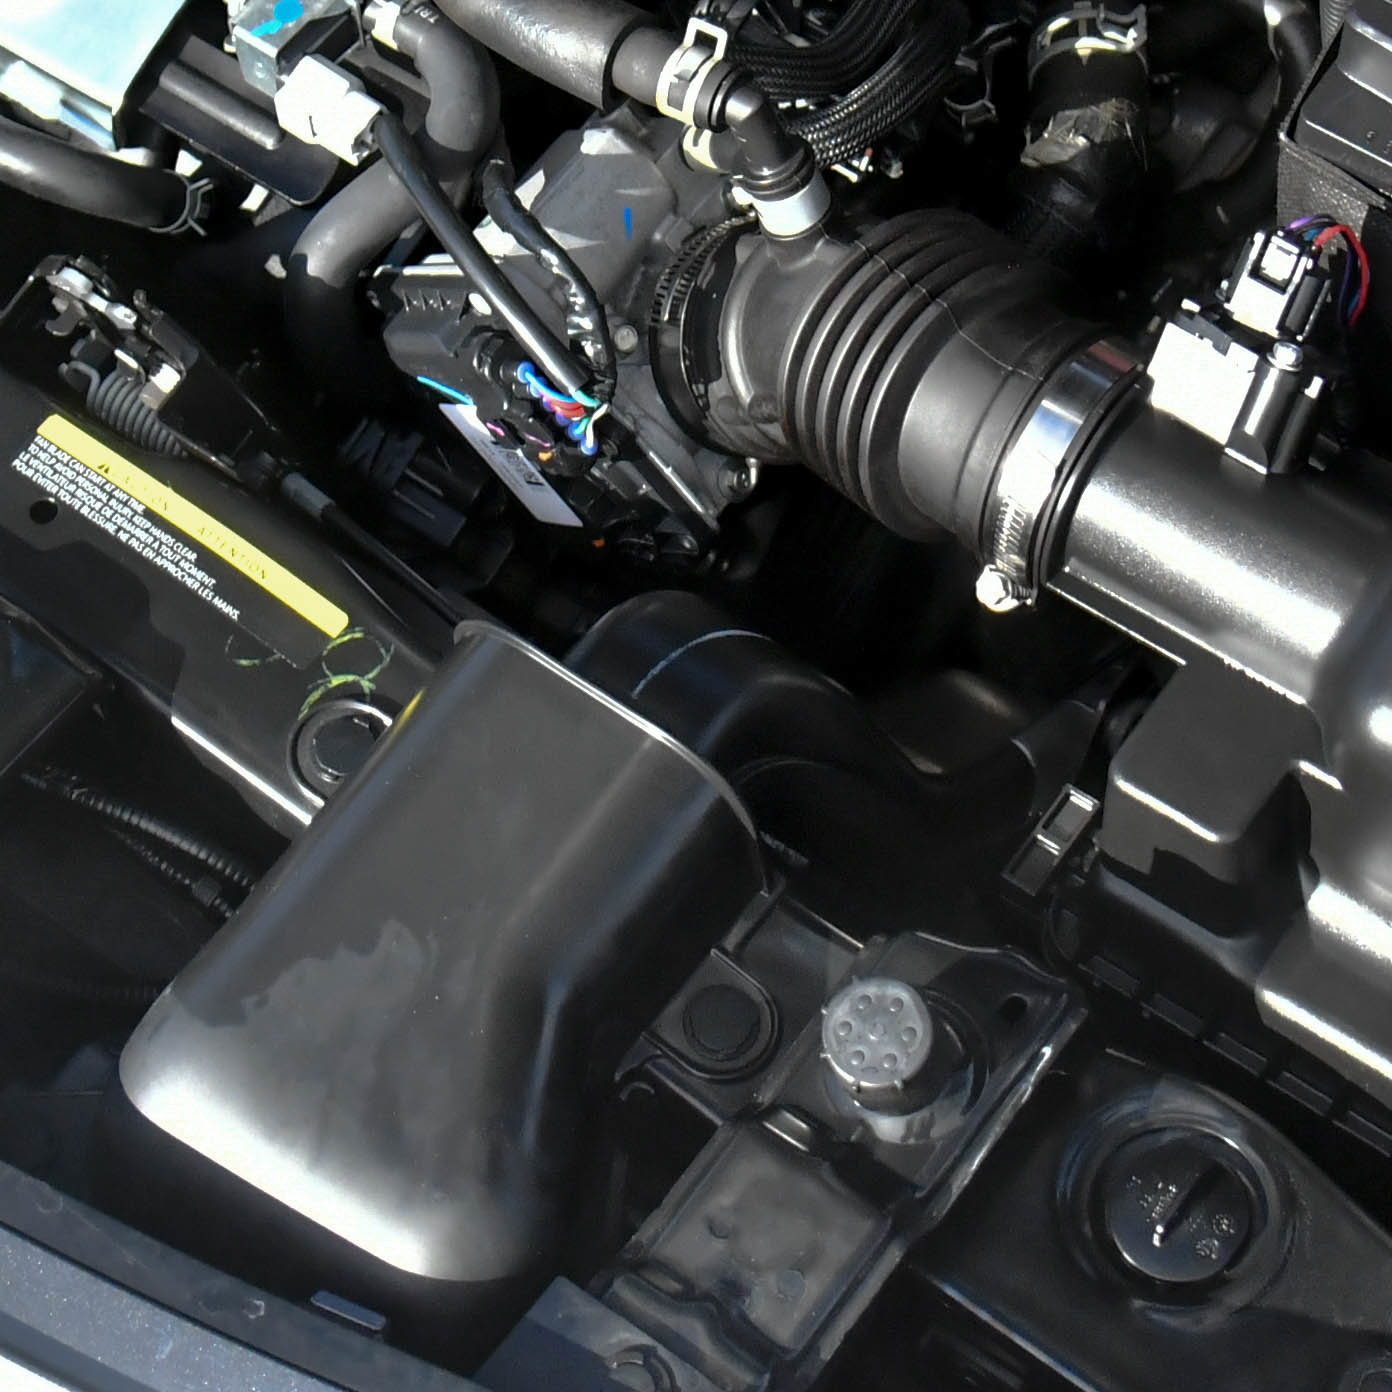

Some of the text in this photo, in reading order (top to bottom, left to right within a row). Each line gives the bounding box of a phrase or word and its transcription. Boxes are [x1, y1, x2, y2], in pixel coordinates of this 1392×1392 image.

[18, 450, 31, 463] LE
[27, 456, 77, 493] VENTILATEUR
[73, 487, 103, 511] RISQUE
[100, 505, 114, 518] DE
[157, 543, 181, 564] TOUT
[26, 443, 39, 455] TO
[36, 449, 56, 467] HELP
[53, 460, 77, 481] AVOID
[74, 474, 110, 503] PERSONAL
[131, 512, 152, 531] KEEP
[148, 524, 176, 547] HANDS
[33, 433, 50, 449] FAN
[46, 442, 71, 464] BLADE
[67, 457, 87, 474] CAN
[83, 468, 106, 487] START
[102, 481, 115, 493] AT
[111, 487, 130, 504] ANY
[11, 457, 35, 478] POUR
[56, 488, 82, 510] TOUTE
[116, 529, 130, 543] NE
[127, 536, 145, 553] PAS
[141, 546, 156, 560] EN
[152, 554, 201, 591] APPROCHER
[197, 585, 214, 601] LES
